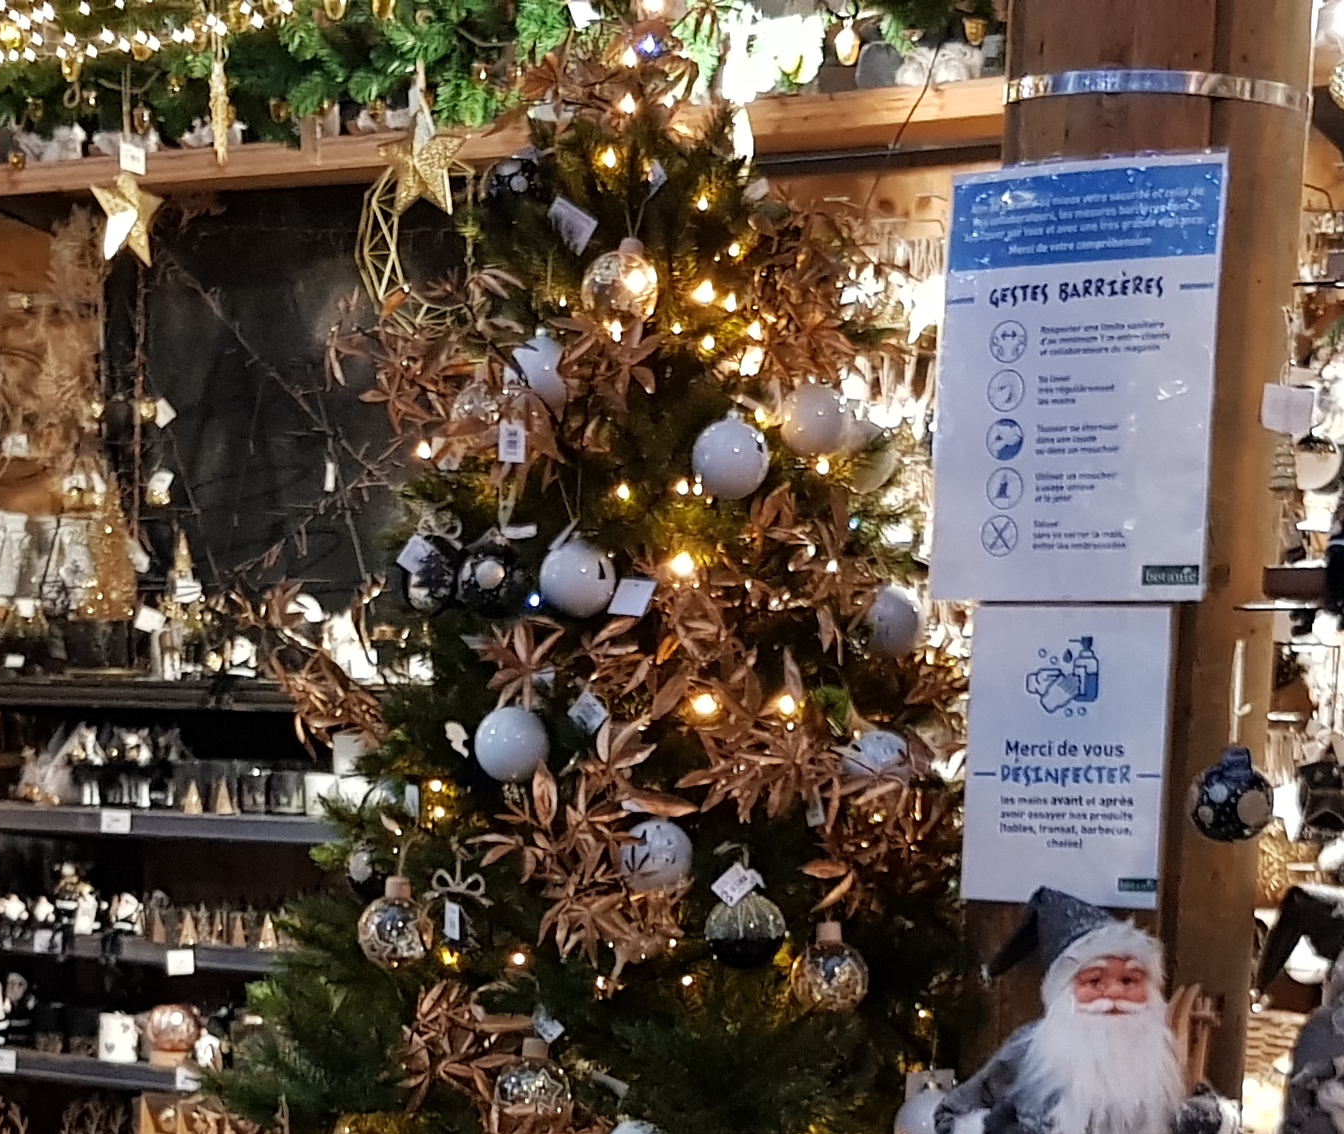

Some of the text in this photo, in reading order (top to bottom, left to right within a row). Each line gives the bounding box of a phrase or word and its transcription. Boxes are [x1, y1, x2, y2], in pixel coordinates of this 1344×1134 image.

[989, 271, 1163, 308] GESTES BARRIÈRES
[1006, 740, 1125, 757] Merci de vous
[1000, 794, 1134, 807] les mains avant et après
[1000, 810, 1133, 822] avoir essayer nos produits
